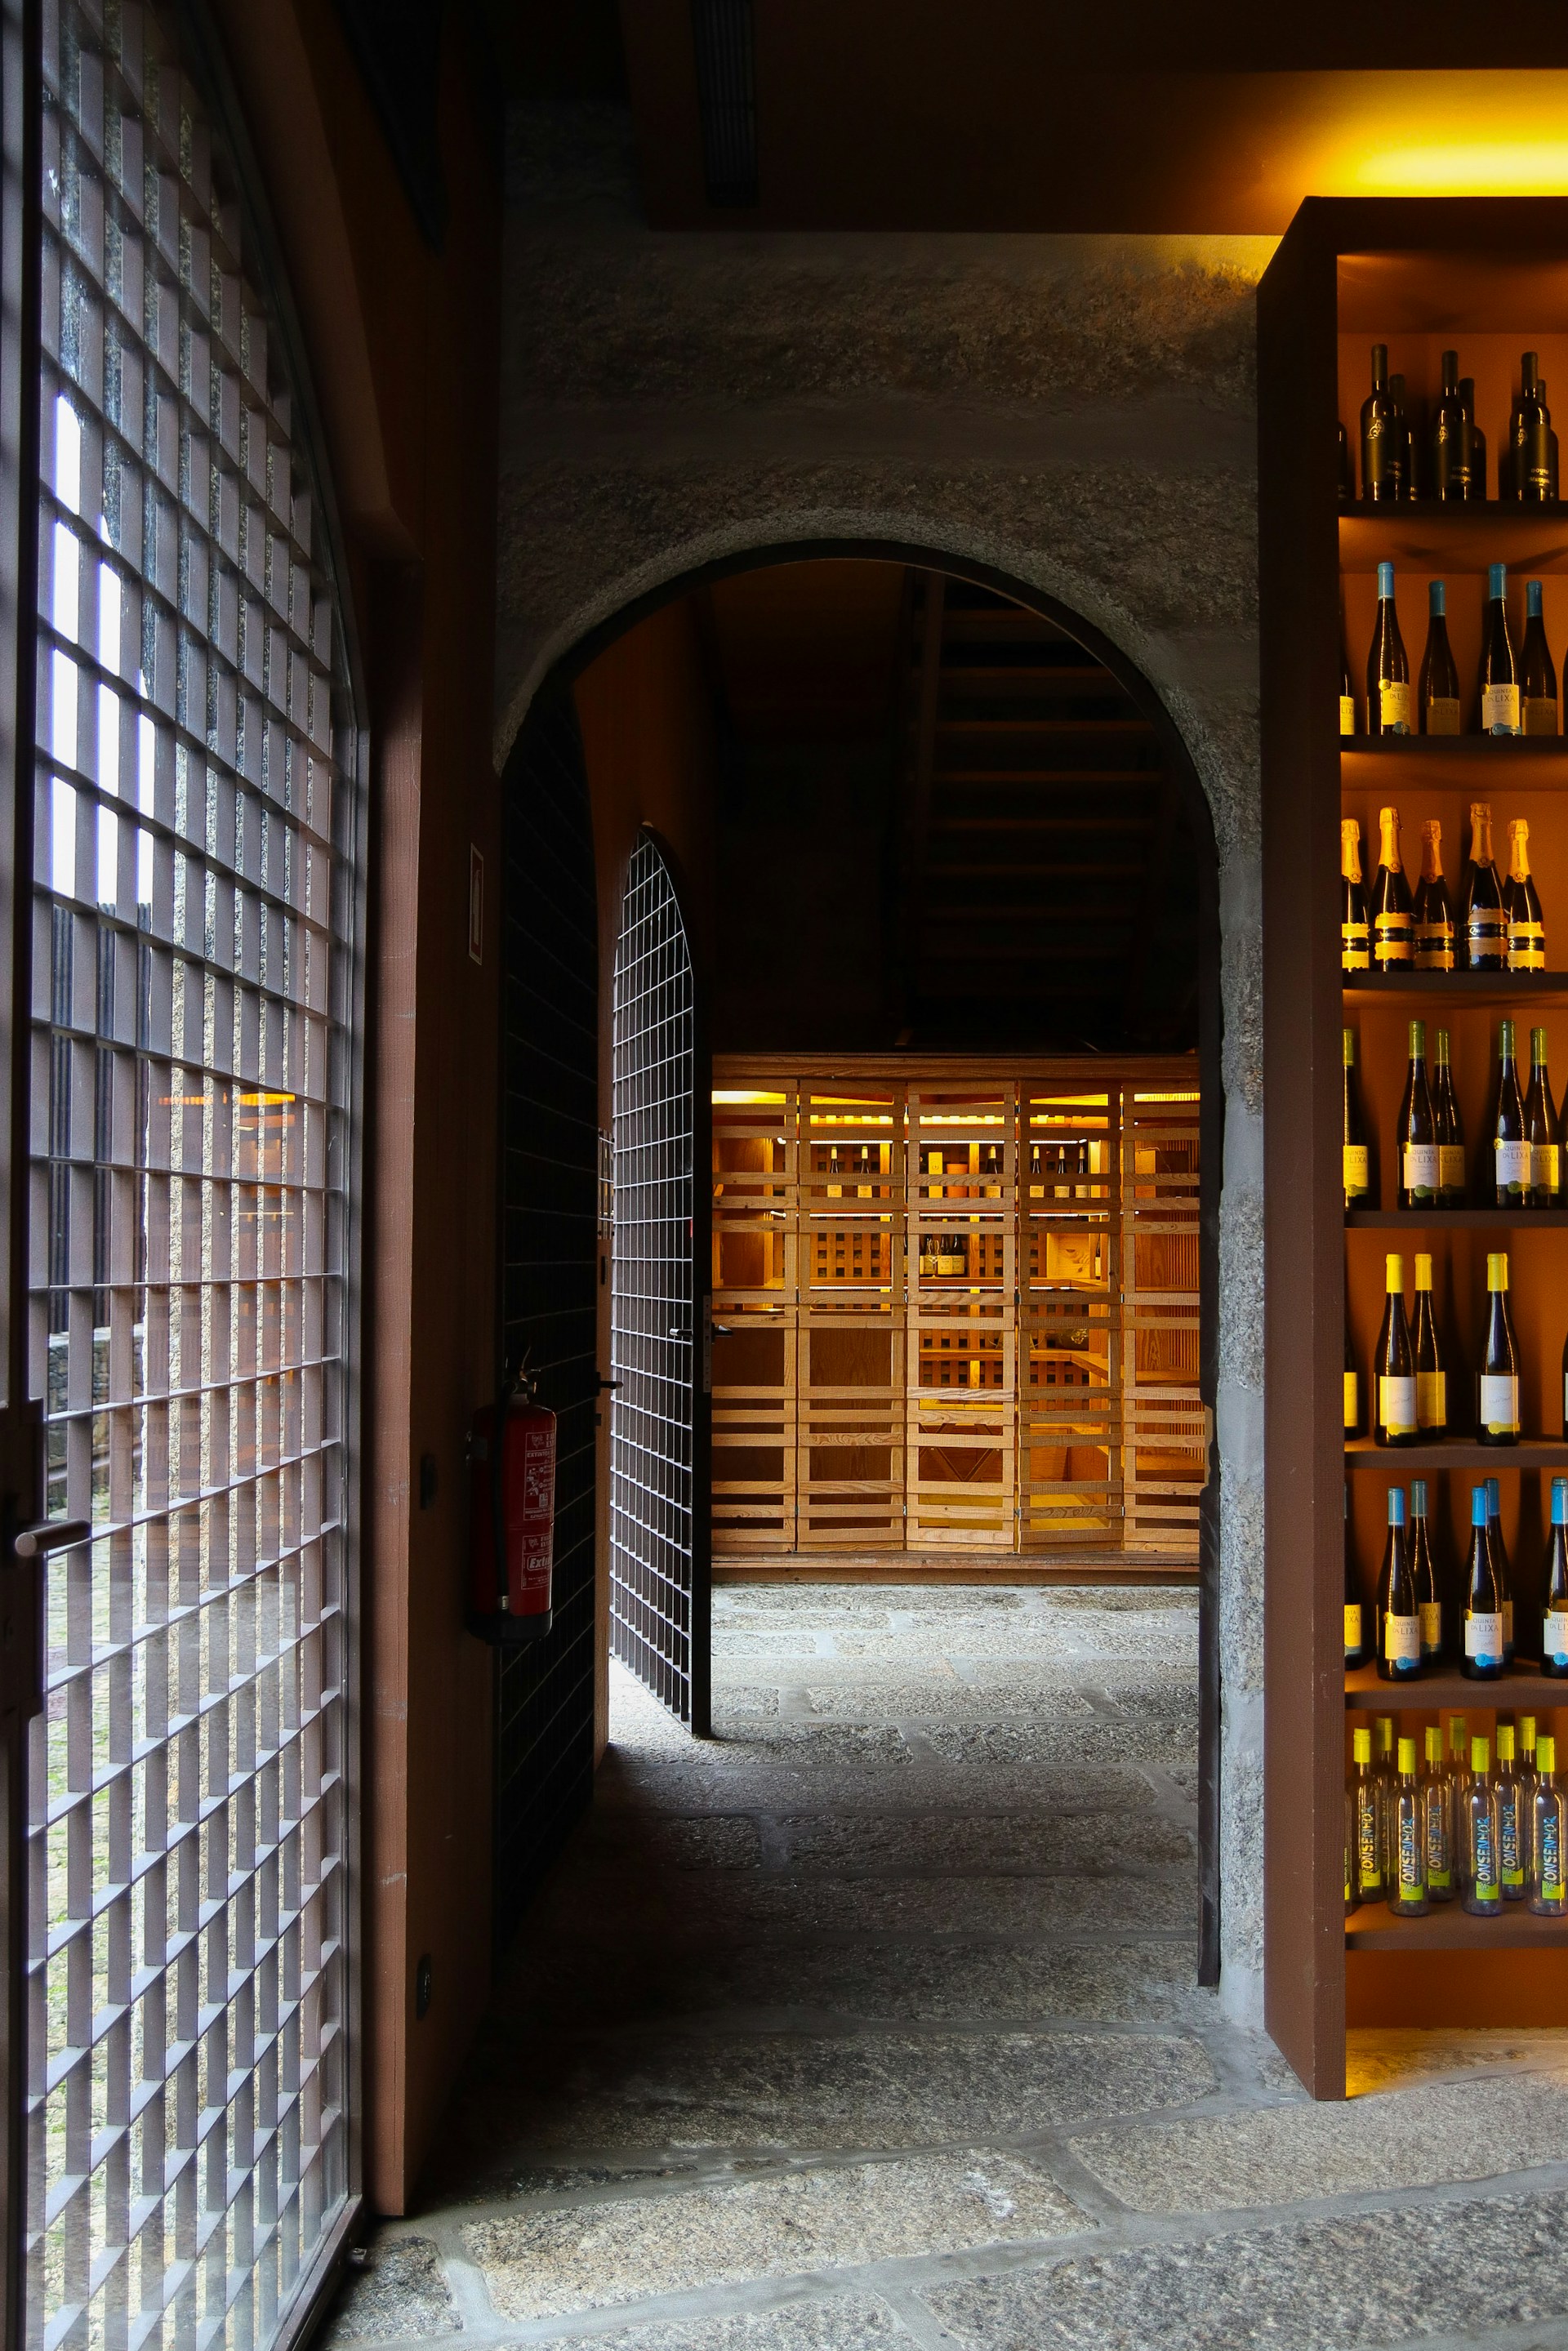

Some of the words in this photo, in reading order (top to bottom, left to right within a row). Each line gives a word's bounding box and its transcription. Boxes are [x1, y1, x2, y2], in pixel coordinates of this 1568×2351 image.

[1494, 694, 1516, 702] LIXA
[1349, 1155, 1367, 1164] LIXA
[1418, 1155, 1438, 1164] LIXA
[1511, 1151, 1529, 1160] LIXA
[1401, 1627, 1419, 1635] LIXA
[1479, 1624, 1499, 1632] LIXA
